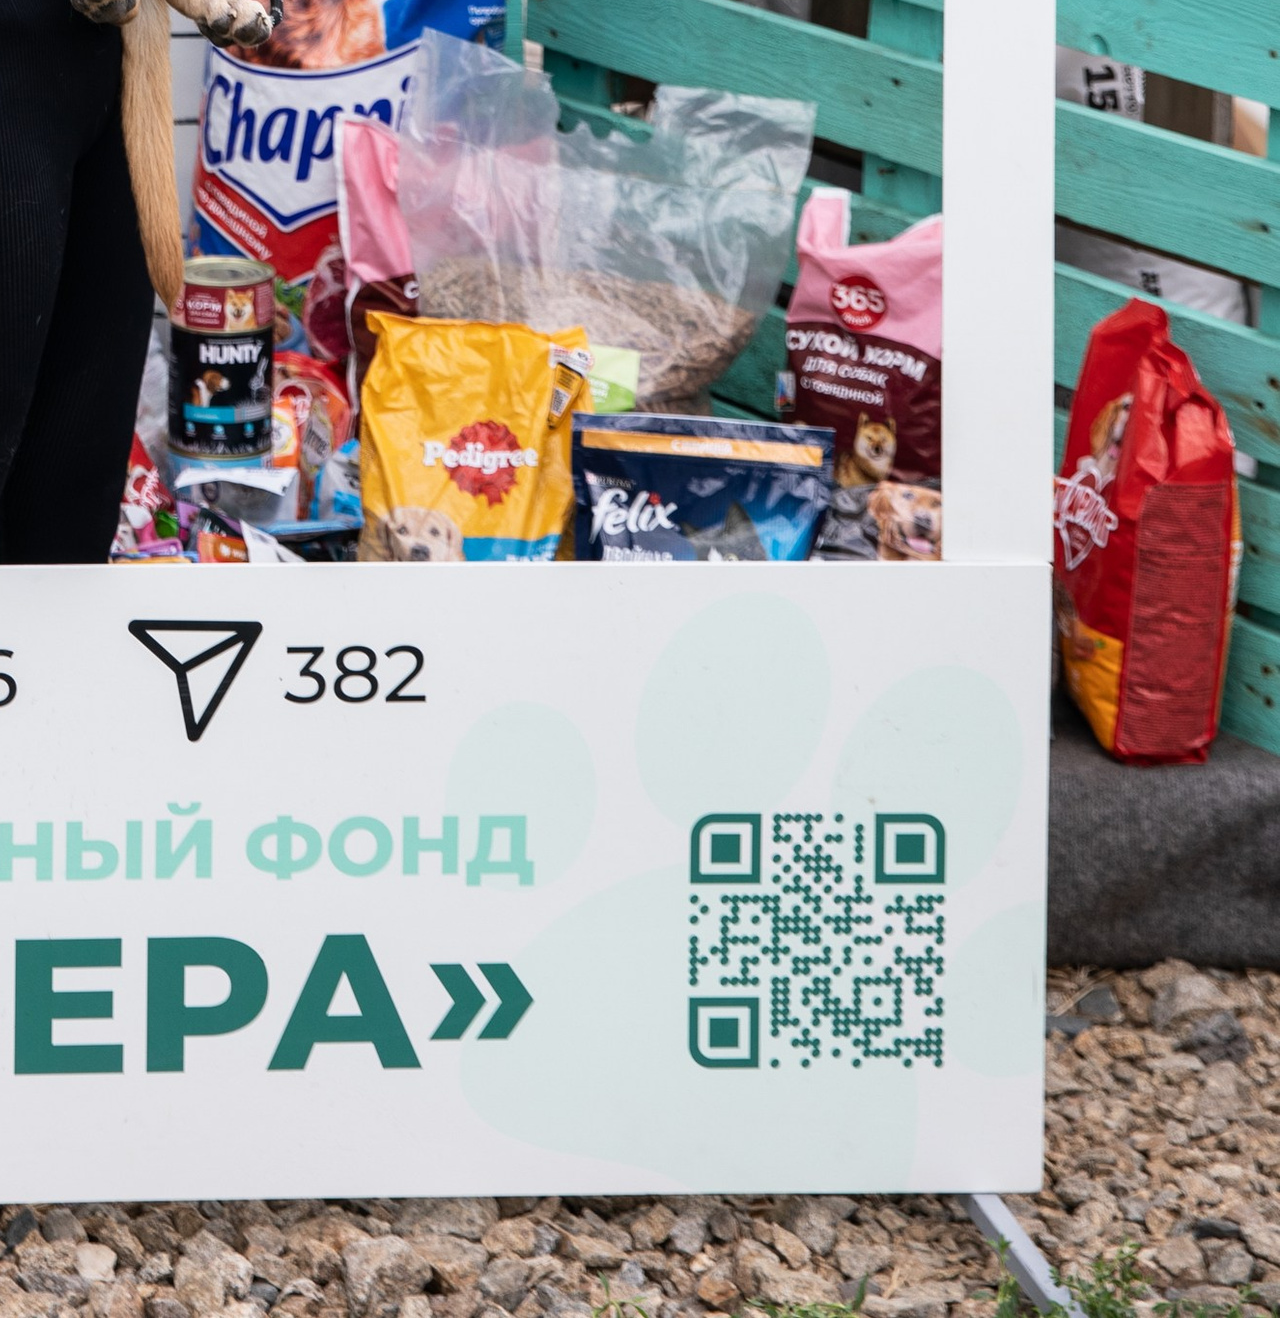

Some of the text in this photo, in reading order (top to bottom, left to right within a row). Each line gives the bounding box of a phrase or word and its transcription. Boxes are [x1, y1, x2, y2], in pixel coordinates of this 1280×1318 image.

[204, 73, 415, 183] Chap
[831, 284, 886, 314] 365
[199, 342, 263, 364] HUNTY
[785, 329, 928, 383] СУХОЙ КОРМ
[422, 440, 539, 475] Pedigree
[587, 487, 678, 545] felix
[284, 645, 426, 704] 382
[246, 815, 535, 886] ФОНД
